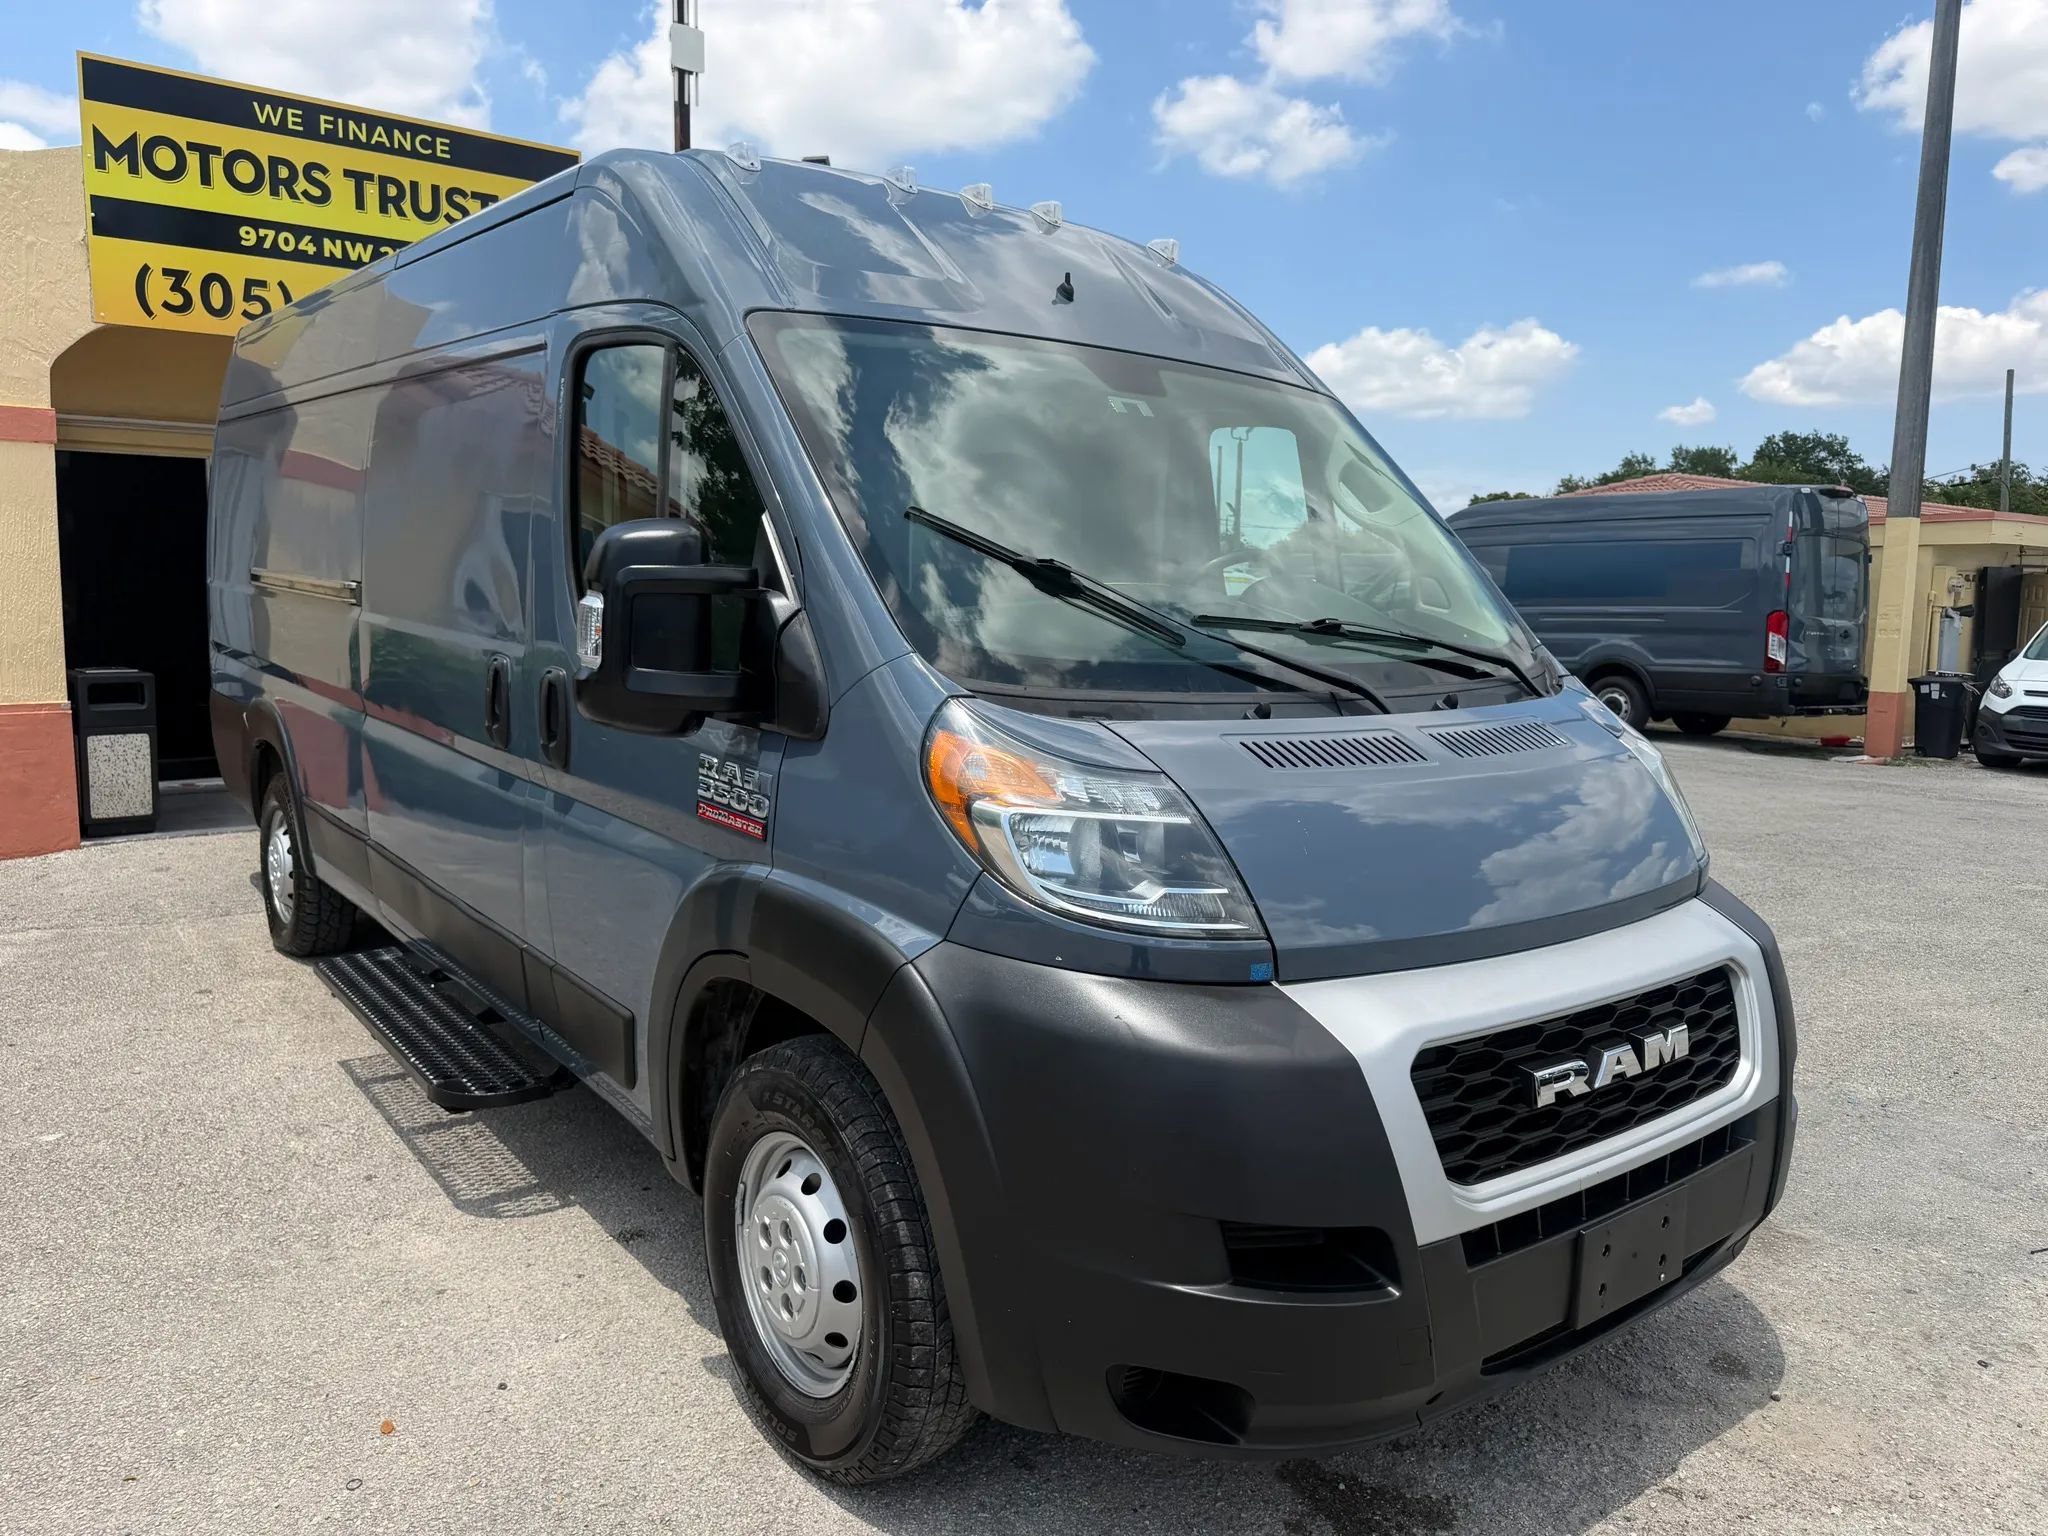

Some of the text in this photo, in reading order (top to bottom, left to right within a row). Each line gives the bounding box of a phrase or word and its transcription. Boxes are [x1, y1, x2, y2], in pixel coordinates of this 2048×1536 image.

[253, 101, 451, 158] WE FINANCE
[91, 123, 500, 225] MOTORS TRUST
[239, 226, 317, 255] 9704
[323, 237, 374, 263] NW
[135, 262, 294, 321] (305)
[697, 775, 770, 819] 3500
[698, 752, 773, 796] RAM
[1533, 1021, 1690, 1108] RAM
